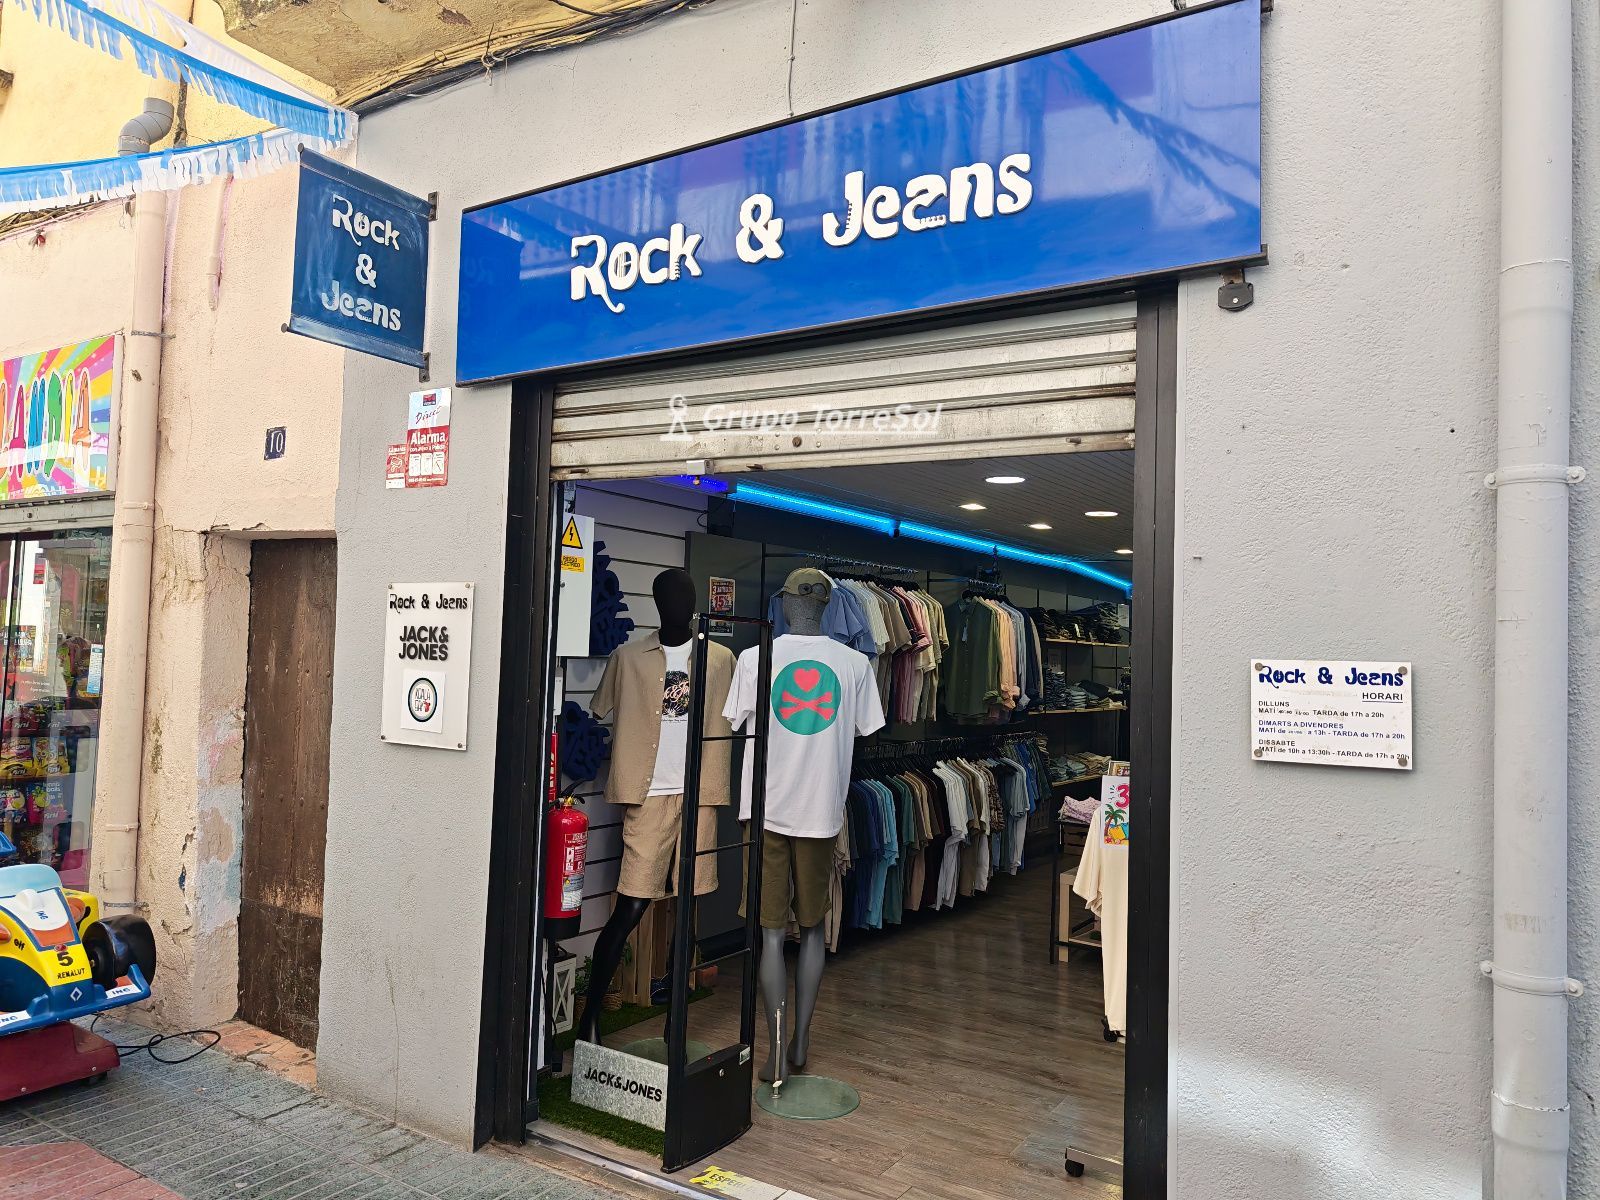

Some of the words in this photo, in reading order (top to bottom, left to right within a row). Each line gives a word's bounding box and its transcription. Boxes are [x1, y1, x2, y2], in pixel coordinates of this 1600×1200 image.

[332, 194, 400, 250] Rock
[571, 222, 702, 313] Rock
[735, 193, 784, 264] &
[822, 153, 1034, 247] Jeans
[355, 253, 377, 289] &
[321, 280, 402, 331] Jeans
[270, 430, 284, 452] 10
[410, 431, 446, 445] Alarma
[389, 593, 415, 613] Rock
[421, 593, 430, 609] &
[436, 594, 468, 610] Jeans
[399, 626, 449, 643] JACK&
[398, 642, 449, 661] JONES
[1259, 666, 1306, 689] Rock
[1317, 667, 1333, 685] &
[1345, 667, 1404, 687] Jeans
[1361, 692, 1403, 701] HORARI
[1313, 709, 1339, 717] TARDA
[1300, 721, 1344, 729] DIVENDRES
[13, 938, 26, 951] elf
[56, 951, 74, 967] 5
[584, 1067, 663, 1102] JACK&JONES
